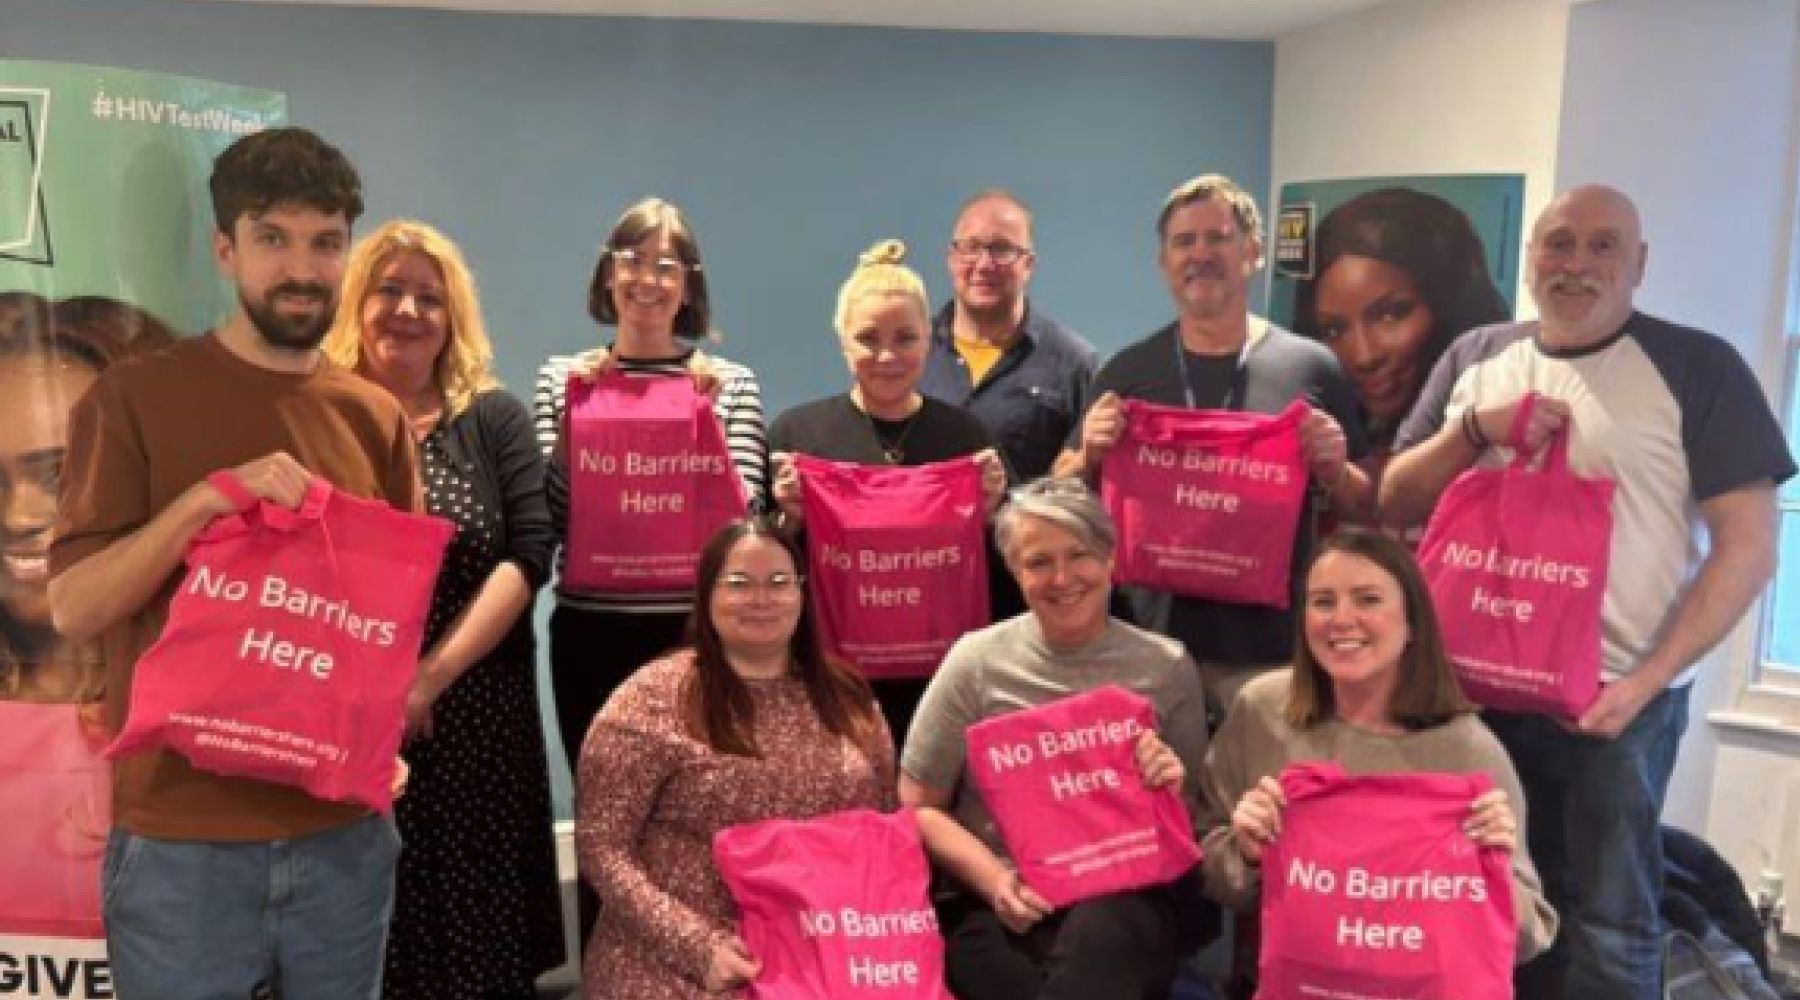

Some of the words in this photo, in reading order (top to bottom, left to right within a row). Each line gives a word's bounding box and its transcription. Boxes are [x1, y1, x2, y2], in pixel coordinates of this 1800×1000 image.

[579, 449, 616, 474] No
[624, 450, 726, 476] Barriers
[1138, 445, 1175, 467] No
[1183, 448, 1289, 484] Barriers
[621, 490, 685, 513] Here
[1176, 484, 1240, 513] Here
[821, 543, 851, 570] No
[859, 546, 961, 573] Barriers
[1441, 540, 1482, 570] No
[189, 566, 248, 601] No
[260, 575, 397, 647] Barriers
[859, 584, 921, 607] Here
[239, 627, 334, 680] Here
[988, 743, 1033, 774] No
[1038, 718, 1142, 759] Barrier
[1050, 766, 1121, 801] Here
[1287, 857, 1337, 894] No
[1345, 867, 1488, 903] Barriers
[1336, 913, 1425, 950] Here
[0, 952, 114, 999] GIVE
[848, 954, 919, 987] Here
